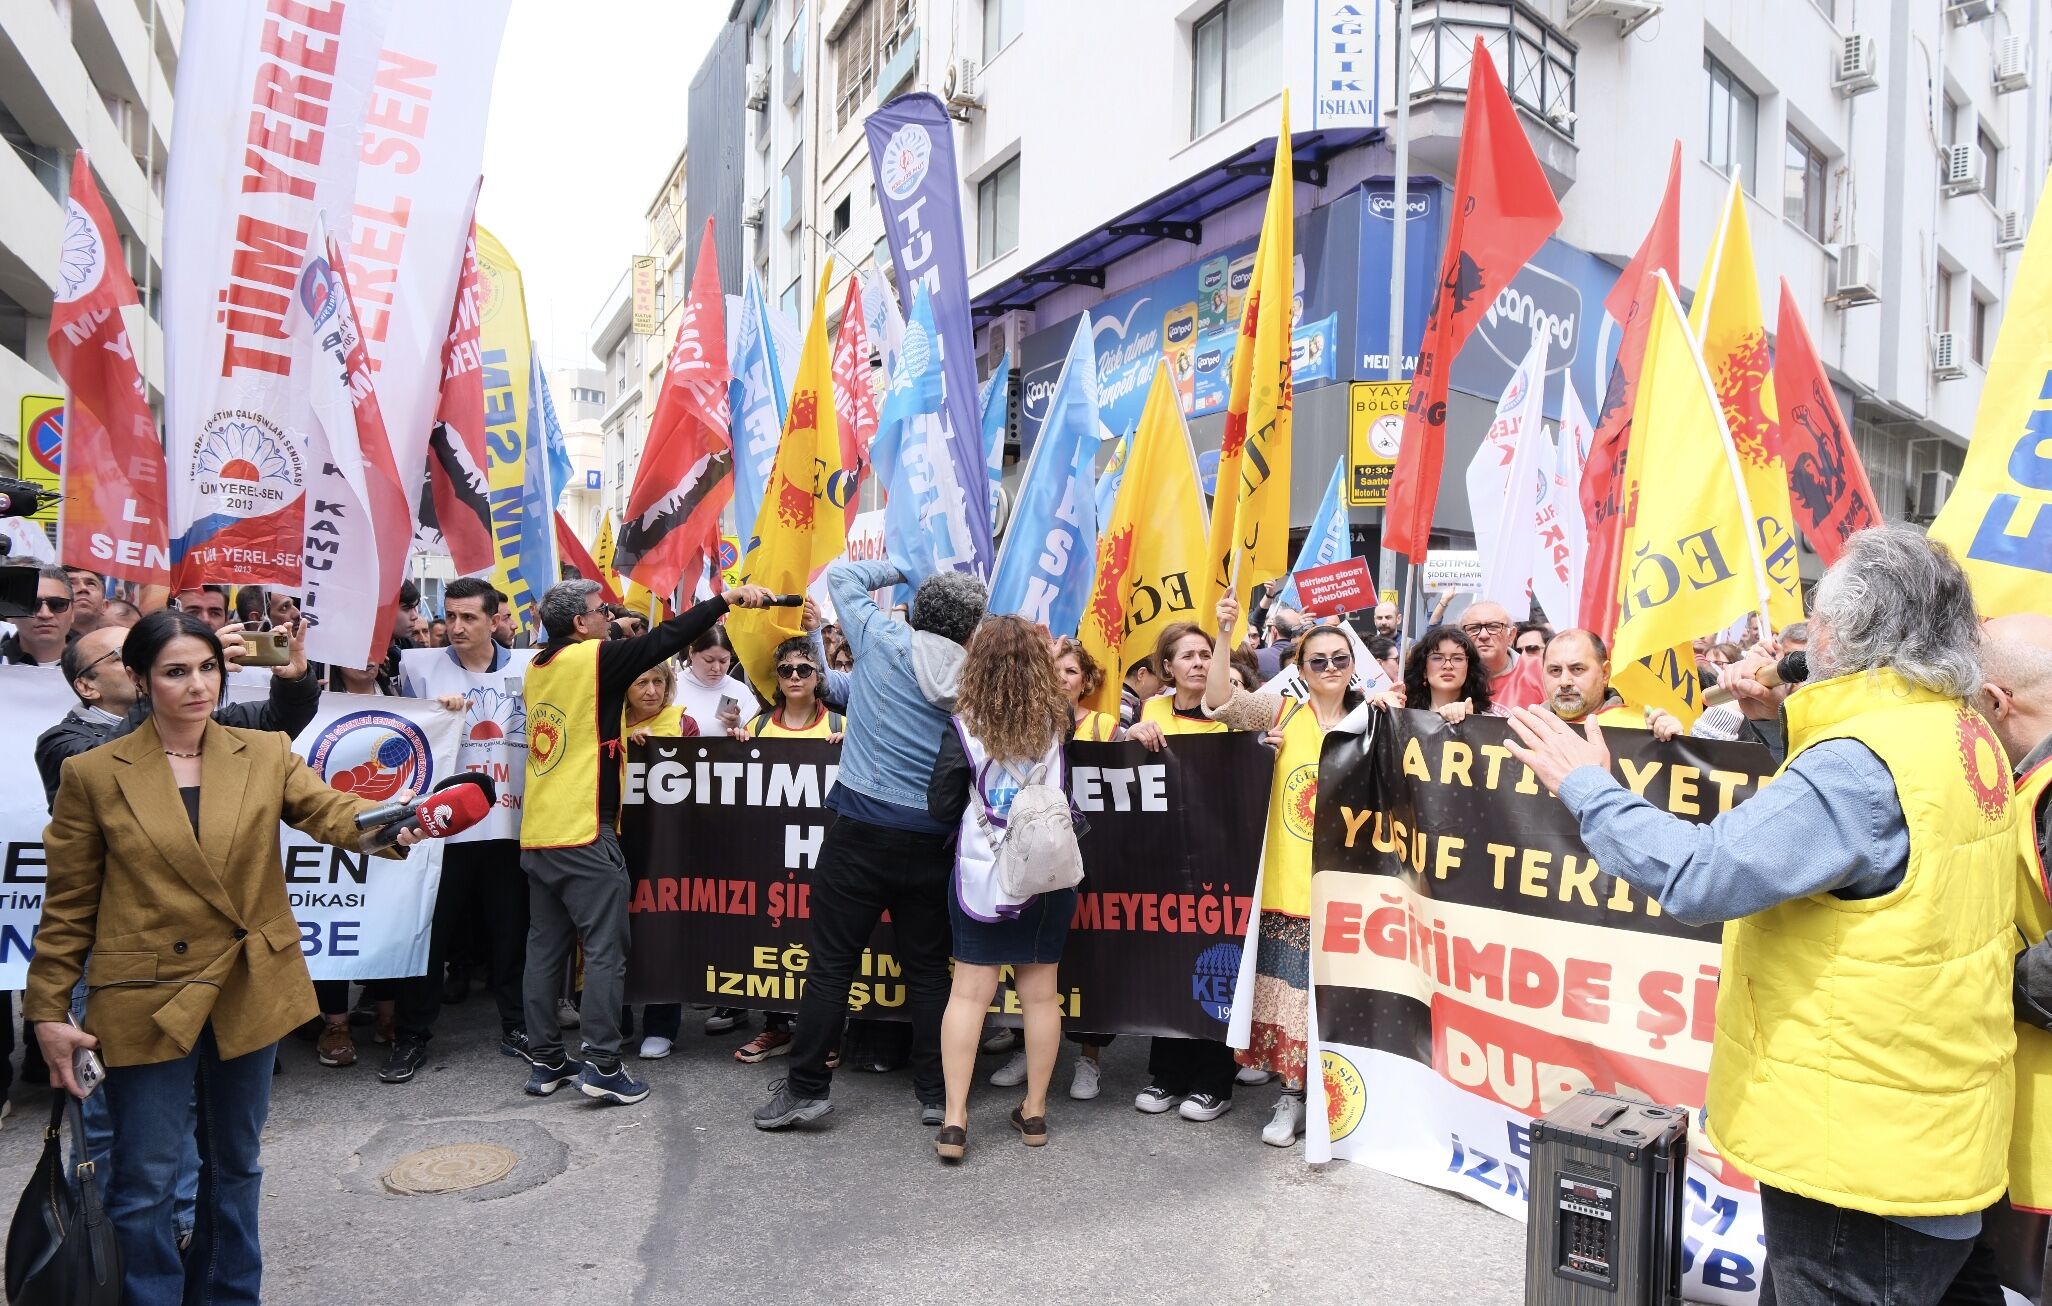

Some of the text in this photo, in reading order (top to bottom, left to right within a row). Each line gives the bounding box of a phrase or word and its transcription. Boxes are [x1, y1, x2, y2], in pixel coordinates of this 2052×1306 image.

[1320, 95, 1373, 119] İŞHANI
[217, 214, 308, 378] TÜM
[1311, 579, 1356, 595] UMUTLARI
[1312, 587, 1361, 605] SÖNDÜRÜR
[1340, 806, 1464, 880] YUSUF
[1322, 893, 1612, 1023] EĞİTİMDE
